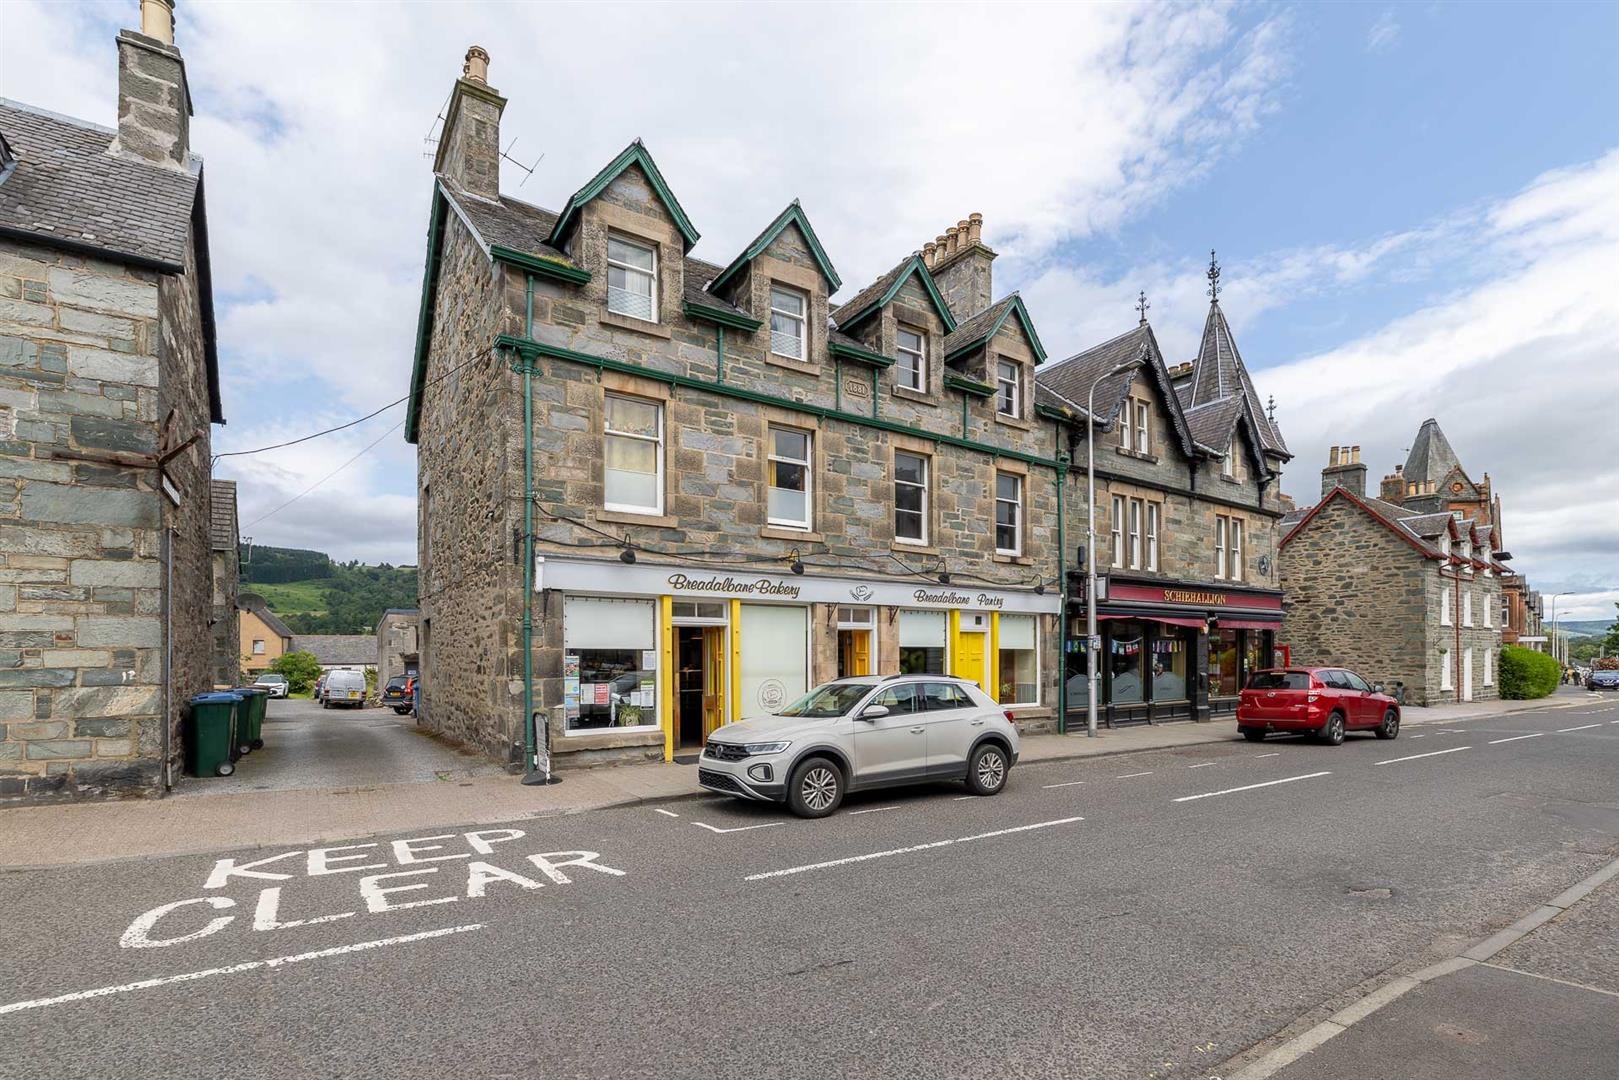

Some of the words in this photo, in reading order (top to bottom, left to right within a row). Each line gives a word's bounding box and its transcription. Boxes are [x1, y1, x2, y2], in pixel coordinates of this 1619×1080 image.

[668, 573, 754, 593] Breadalbane
[754, 579, 801, 599] Bakery
[913, 589, 971, 605] Breadalbane
[977, 593, 1004, 609] Pantry
[1164, 589, 1227, 605] SCHIEHALLION
[203, 828, 526, 889] KEEP
[119, 850, 627, 949] CLEAR
